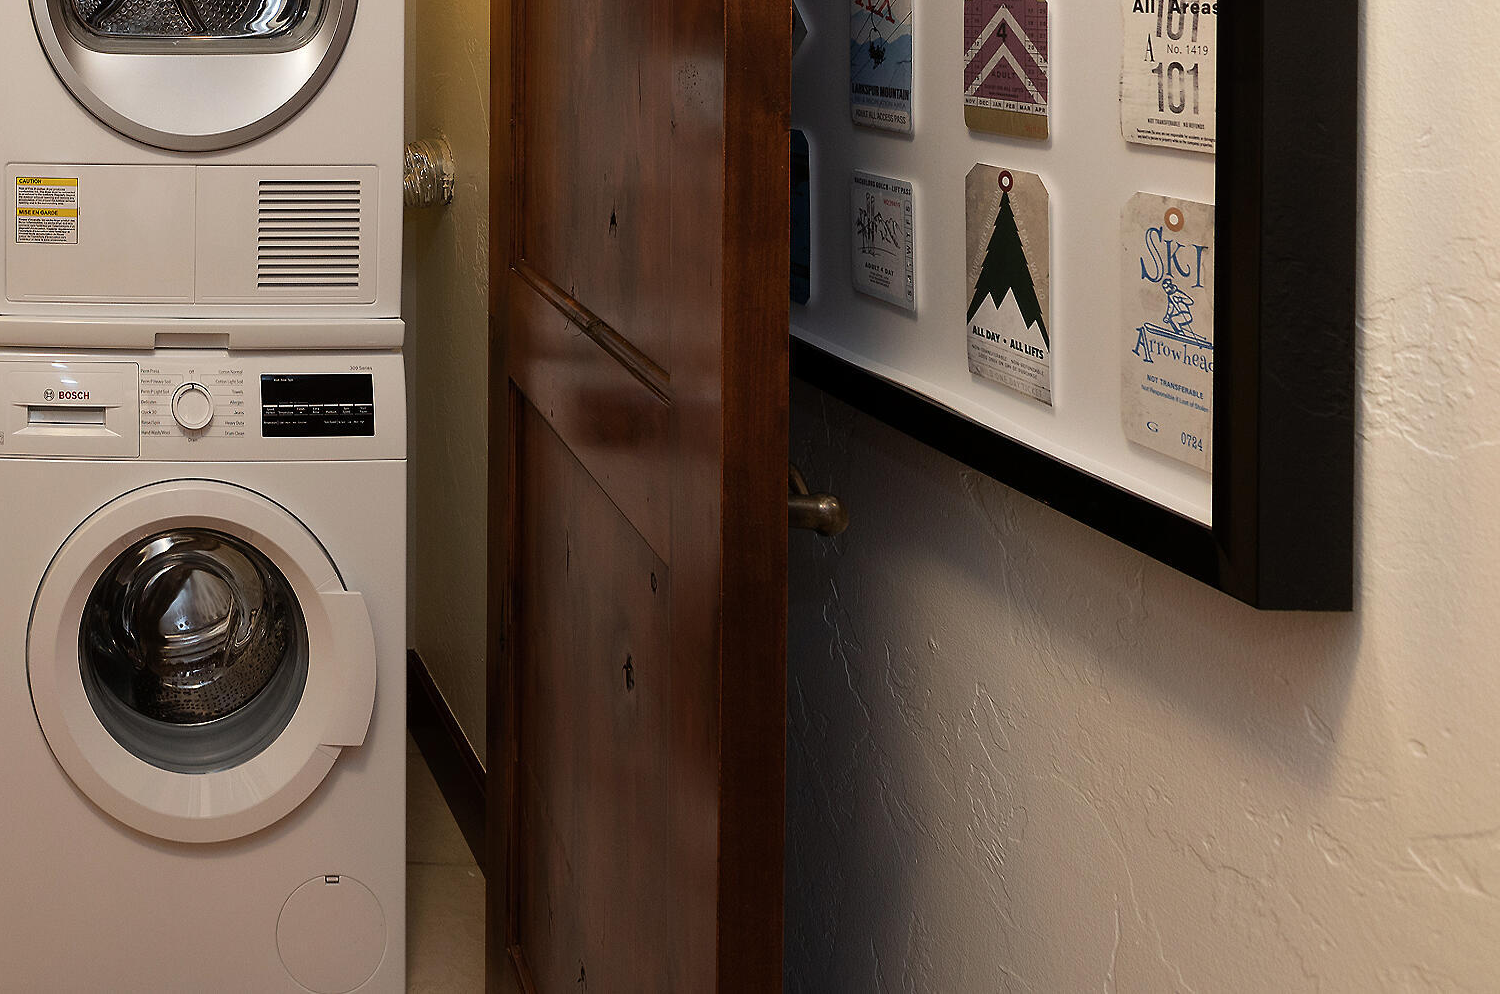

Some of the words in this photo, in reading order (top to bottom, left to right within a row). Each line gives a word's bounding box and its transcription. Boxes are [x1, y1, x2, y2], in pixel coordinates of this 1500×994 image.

[996, 22, 1008, 43] 4
[1166, 44, 1182, 54] No.
[1186, 45, 1209, 56] 1419
[880, 86, 910, 101] MOUNTAIN
[1151, 61, 1200, 115] 101
[894, 114, 906, 125] PASS
[1140, 226, 1209, 289] SKI
[884, 267, 895, 277] DAY
[972, 325, 986, 338] ALL
[986, 329, 1001, 344] DAY
[1010, 338, 1024, 354] ALL
[1024, 343, 1045, 360] LIFTS
[58, 391, 90, 400] BOSCH
[1146, 373, 1159, 385] NOT
[1160, 379, 1205, 400] TRANSFERABLE
